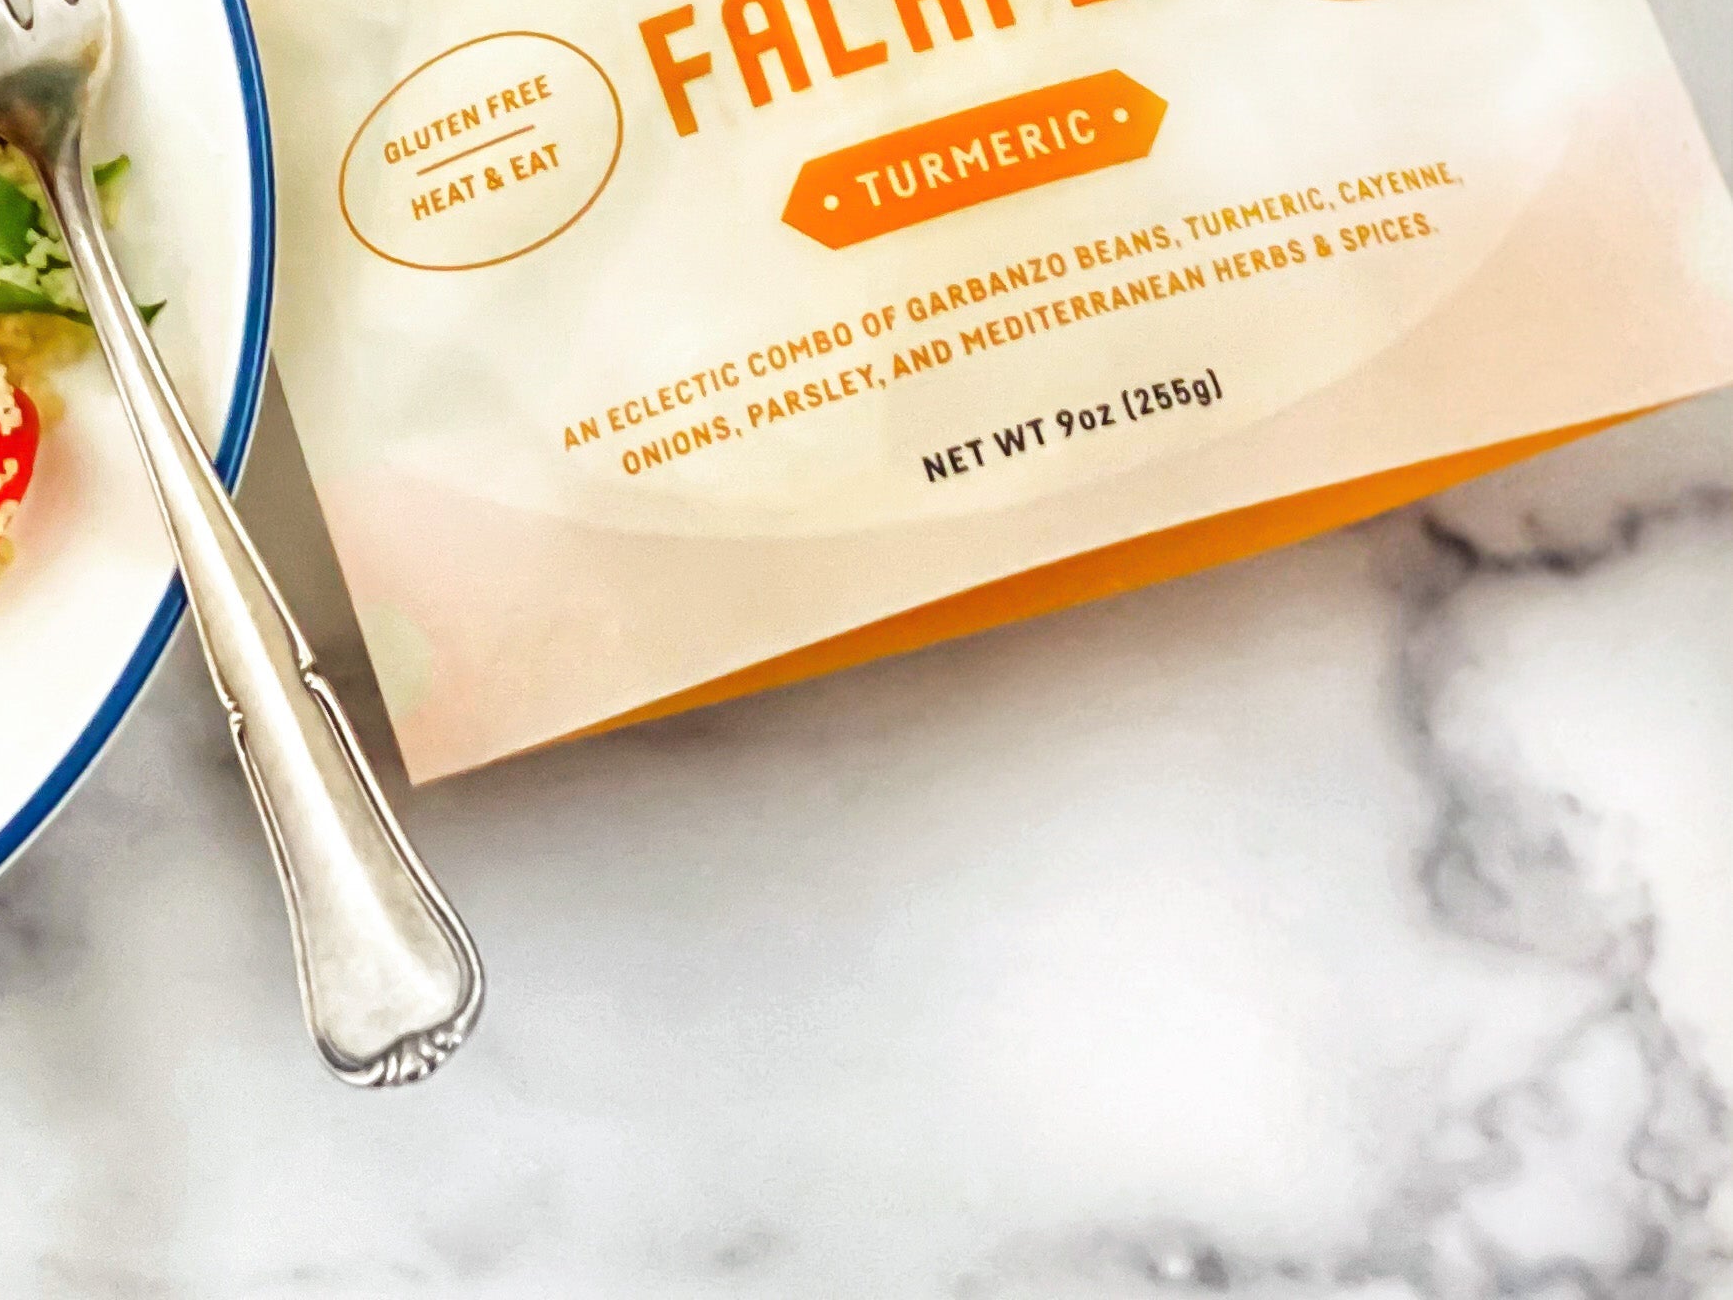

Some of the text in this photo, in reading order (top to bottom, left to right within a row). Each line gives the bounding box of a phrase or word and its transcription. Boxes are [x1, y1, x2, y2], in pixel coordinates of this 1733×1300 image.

[383, 74, 552, 165] GLUTEN FREE
[855, 107, 1098, 208] TURMERIC
[411, 143, 559, 221] HEAT & EAT
[564, 161, 1465, 451] AN ECLECTIC COMBO OF GARBANZO BEANS, TURMERIC, CAYENNE,
[622, 211, 1440, 475] ONIONS, PARSLEY, AND MEDITERRANEAN HERBS & SPICES.
[922, 367, 1223, 483] NET WT 9oz (255g)
